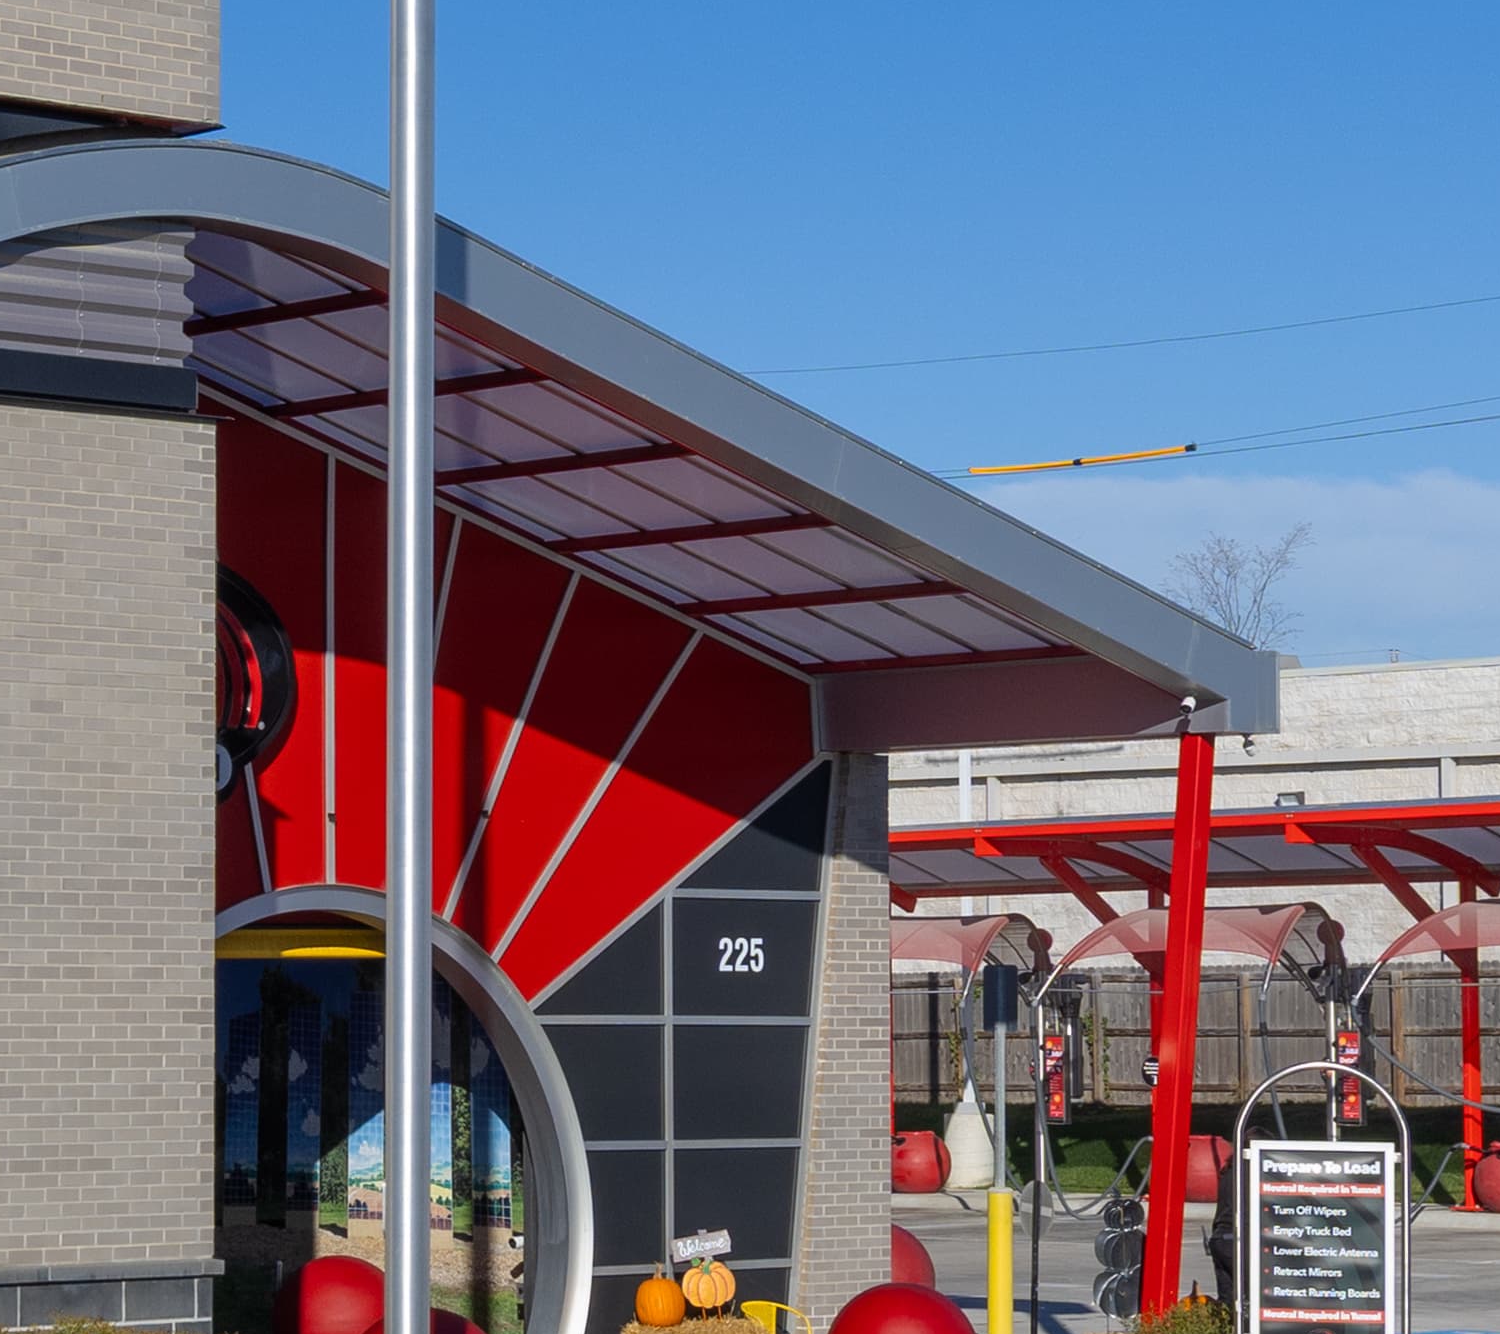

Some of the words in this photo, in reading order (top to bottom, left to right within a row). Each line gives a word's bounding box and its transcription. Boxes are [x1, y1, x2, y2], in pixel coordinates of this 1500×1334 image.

[719, 937, 764, 972] 225
[1262, 1159, 1321, 1176] Prepare
[1322, 1161, 1342, 1174] To
[1343, 1161, 1381, 1174] Load
[1272, 1205, 1295, 1215] Turn
[1296, 1205, 1313, 1215] Off
[1313, 1207, 1347, 1218] Wipers
[1273, 1226, 1304, 1237] Empty
[1305, 1227, 1331, 1236] Truck
[1332, 1227, 1352, 1236] Bed
[677, 1238, 727, 1257] Welcome
[1273, 1246, 1303, 1256] Lower
[1304, 1247, 1338, 1257] Electric
[1339, 1248, 1379, 1258] Antenna
[1273, 1267, 1307, 1277] Retract
[1308, 1267, 1343, 1277] Mirrors
[1273, 1287, 1307, 1297] Retract
[1308, 1288, 1346, 1300] Running
[1347, 1288, 1381, 1298] Boards
